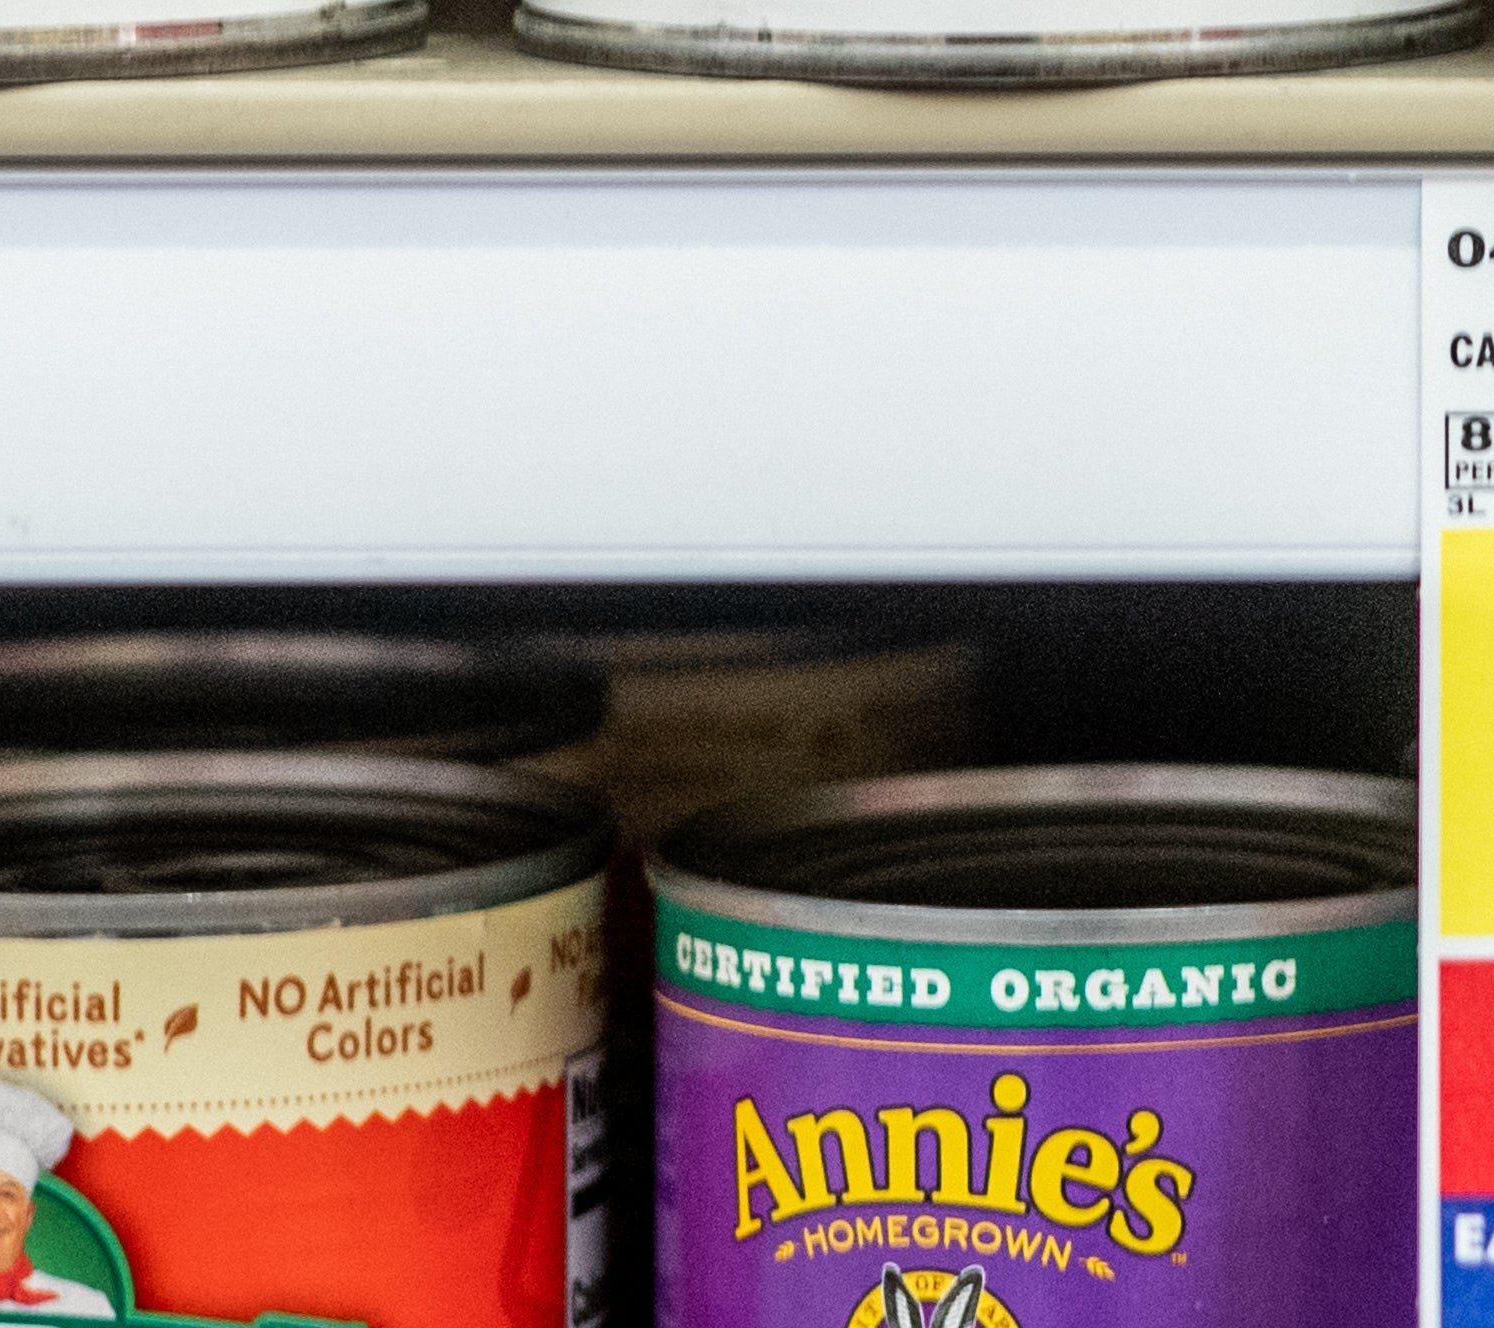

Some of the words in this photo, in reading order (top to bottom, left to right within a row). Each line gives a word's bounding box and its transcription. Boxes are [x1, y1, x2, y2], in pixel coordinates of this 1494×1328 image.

[239, 976, 306, 1019] NO
[317, 953, 486, 1015] Artificial
[671, 927, 957, 1014] CERTIFIED
[990, 959, 1296, 1012] ORGANIC
[306, 1016, 434, 1063] Colors
[733, 1071, 1195, 1258] Annie's
[802, 1215, 1072, 1272] HOMEGROWN
